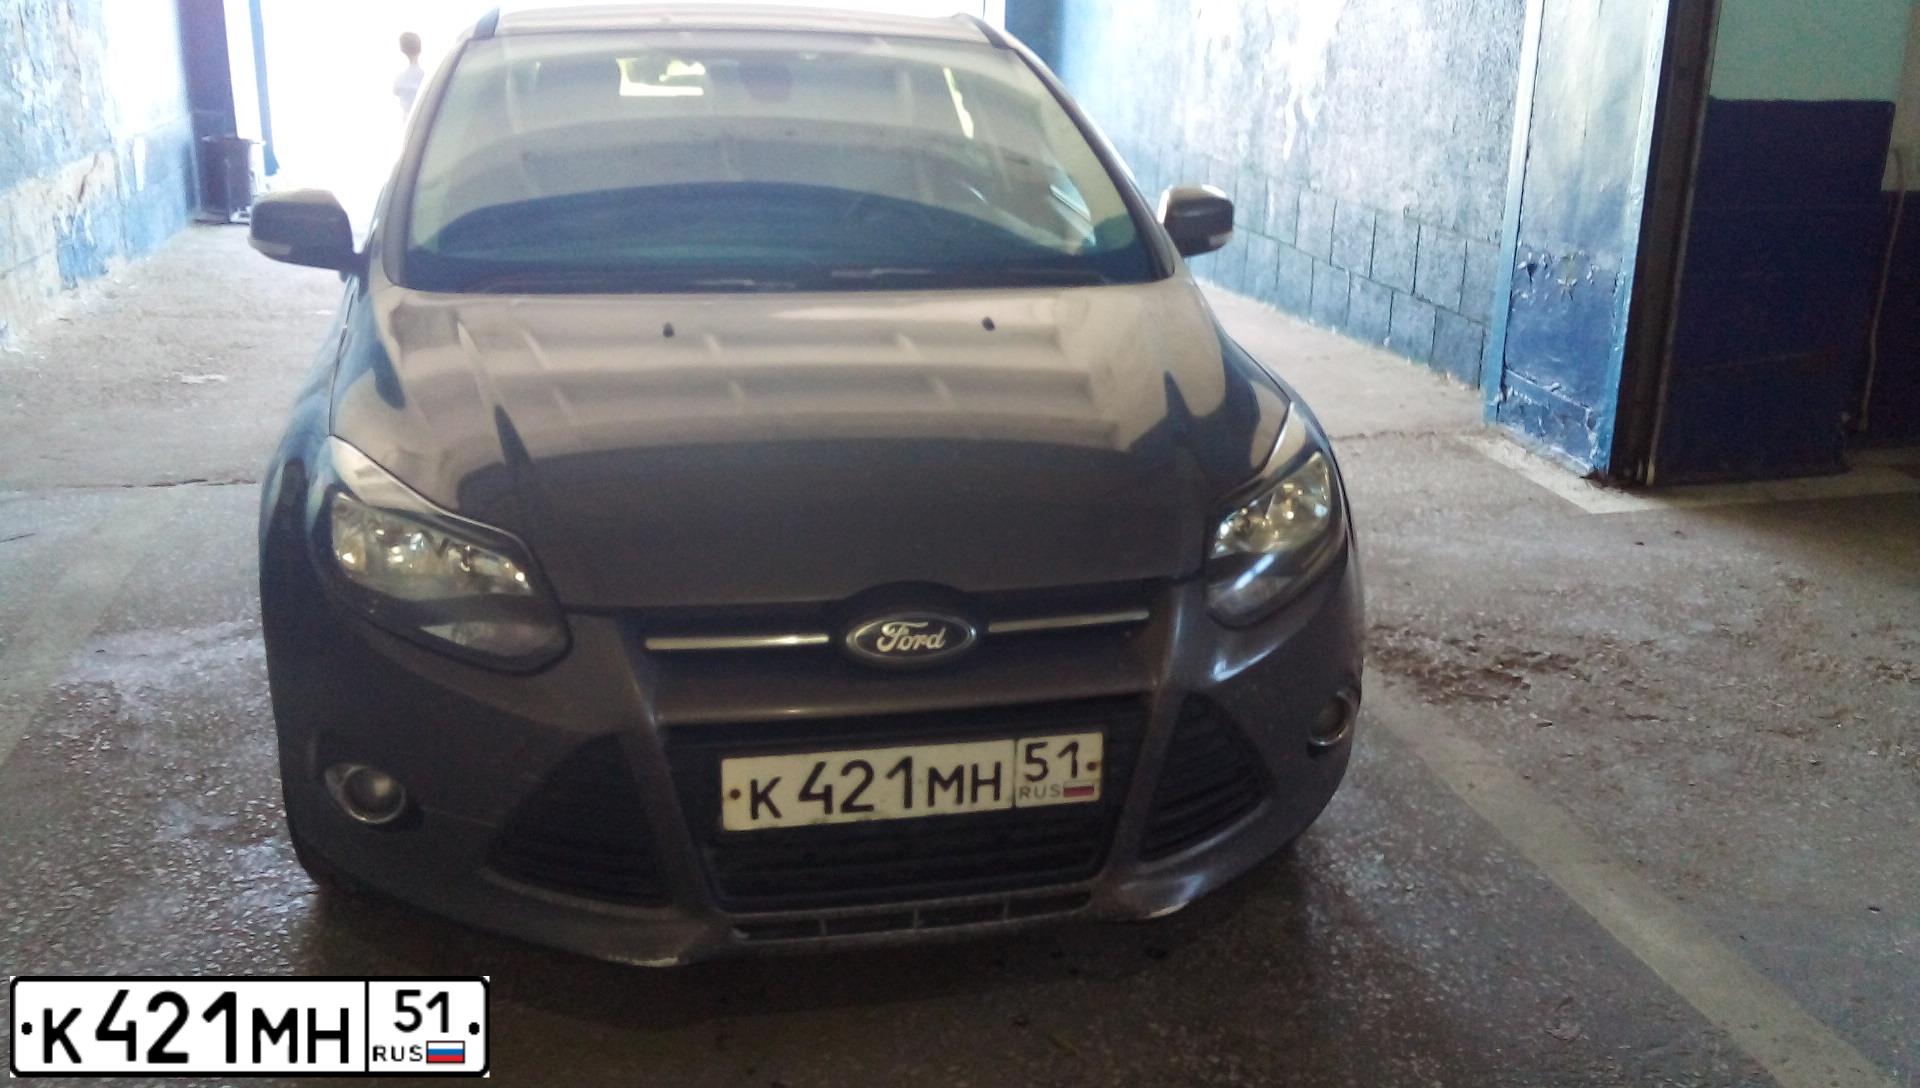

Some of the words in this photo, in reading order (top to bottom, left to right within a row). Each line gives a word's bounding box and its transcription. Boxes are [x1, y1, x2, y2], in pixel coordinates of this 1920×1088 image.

[876, 621, 946, 652] Ford
[1024, 741, 1080, 782] 51
[1018, 784, 1061, 800] RUS
